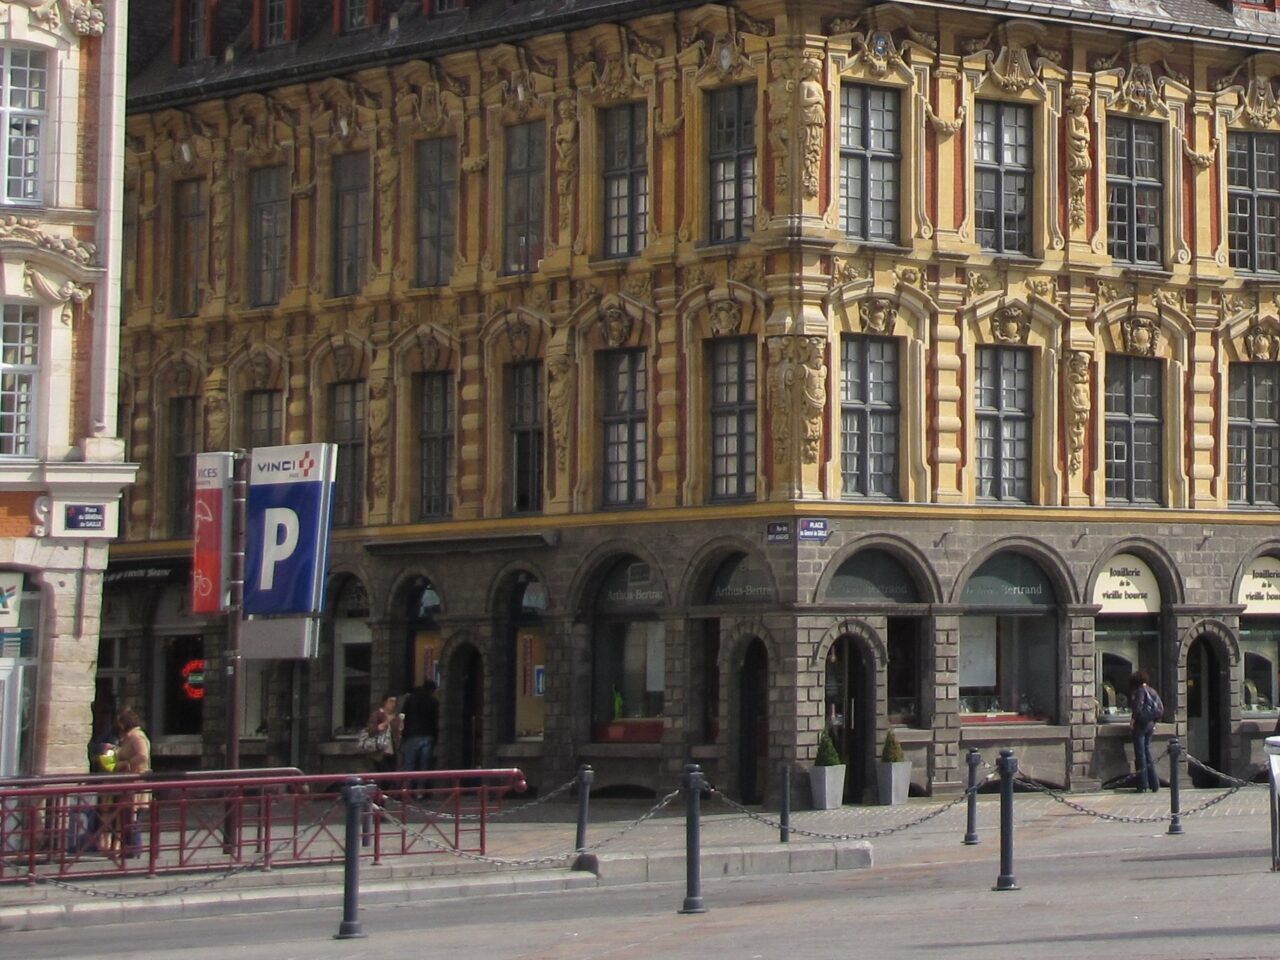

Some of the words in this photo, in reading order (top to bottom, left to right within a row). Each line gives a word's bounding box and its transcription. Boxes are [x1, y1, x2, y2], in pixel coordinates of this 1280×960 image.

[257, 460, 296, 473] VINCI
[809, 521, 824, 529] PLACE
[260, 507, 300, 590] P
[1124, 590, 1148, 600] bourse
